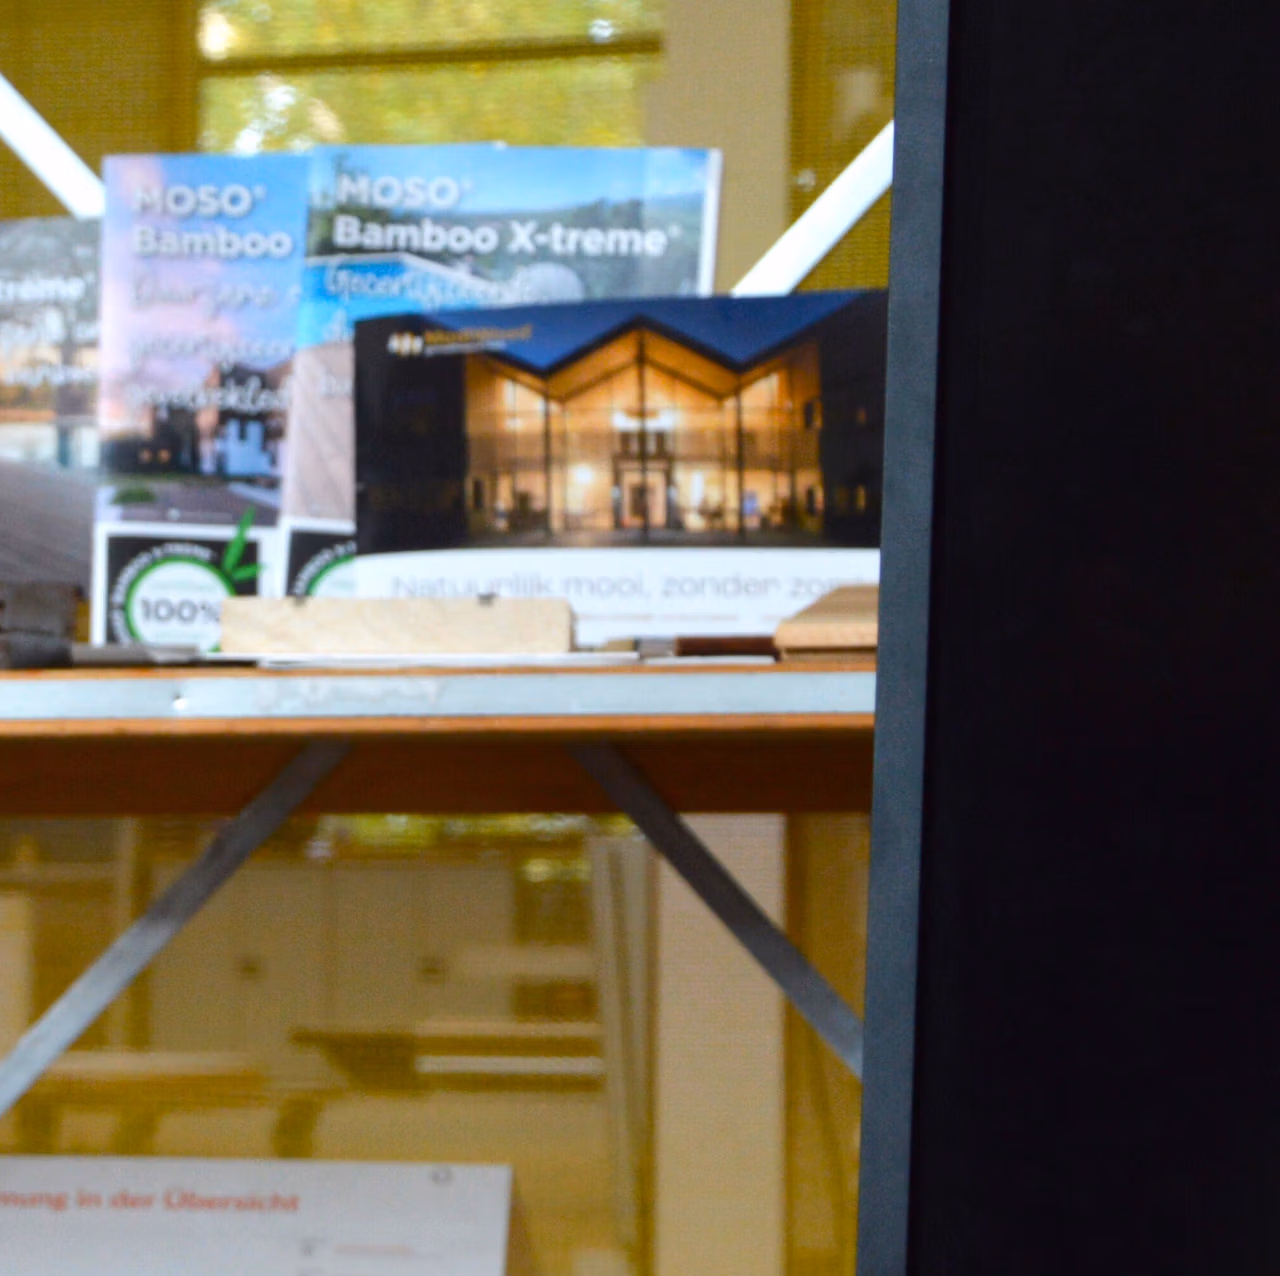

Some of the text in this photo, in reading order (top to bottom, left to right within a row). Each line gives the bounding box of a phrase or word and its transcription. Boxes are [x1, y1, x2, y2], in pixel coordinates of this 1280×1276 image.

[134, 225, 294, 259] Bamboo
[332, 214, 499, 253] Bamboo
[661, 571, 783, 598] zonder
